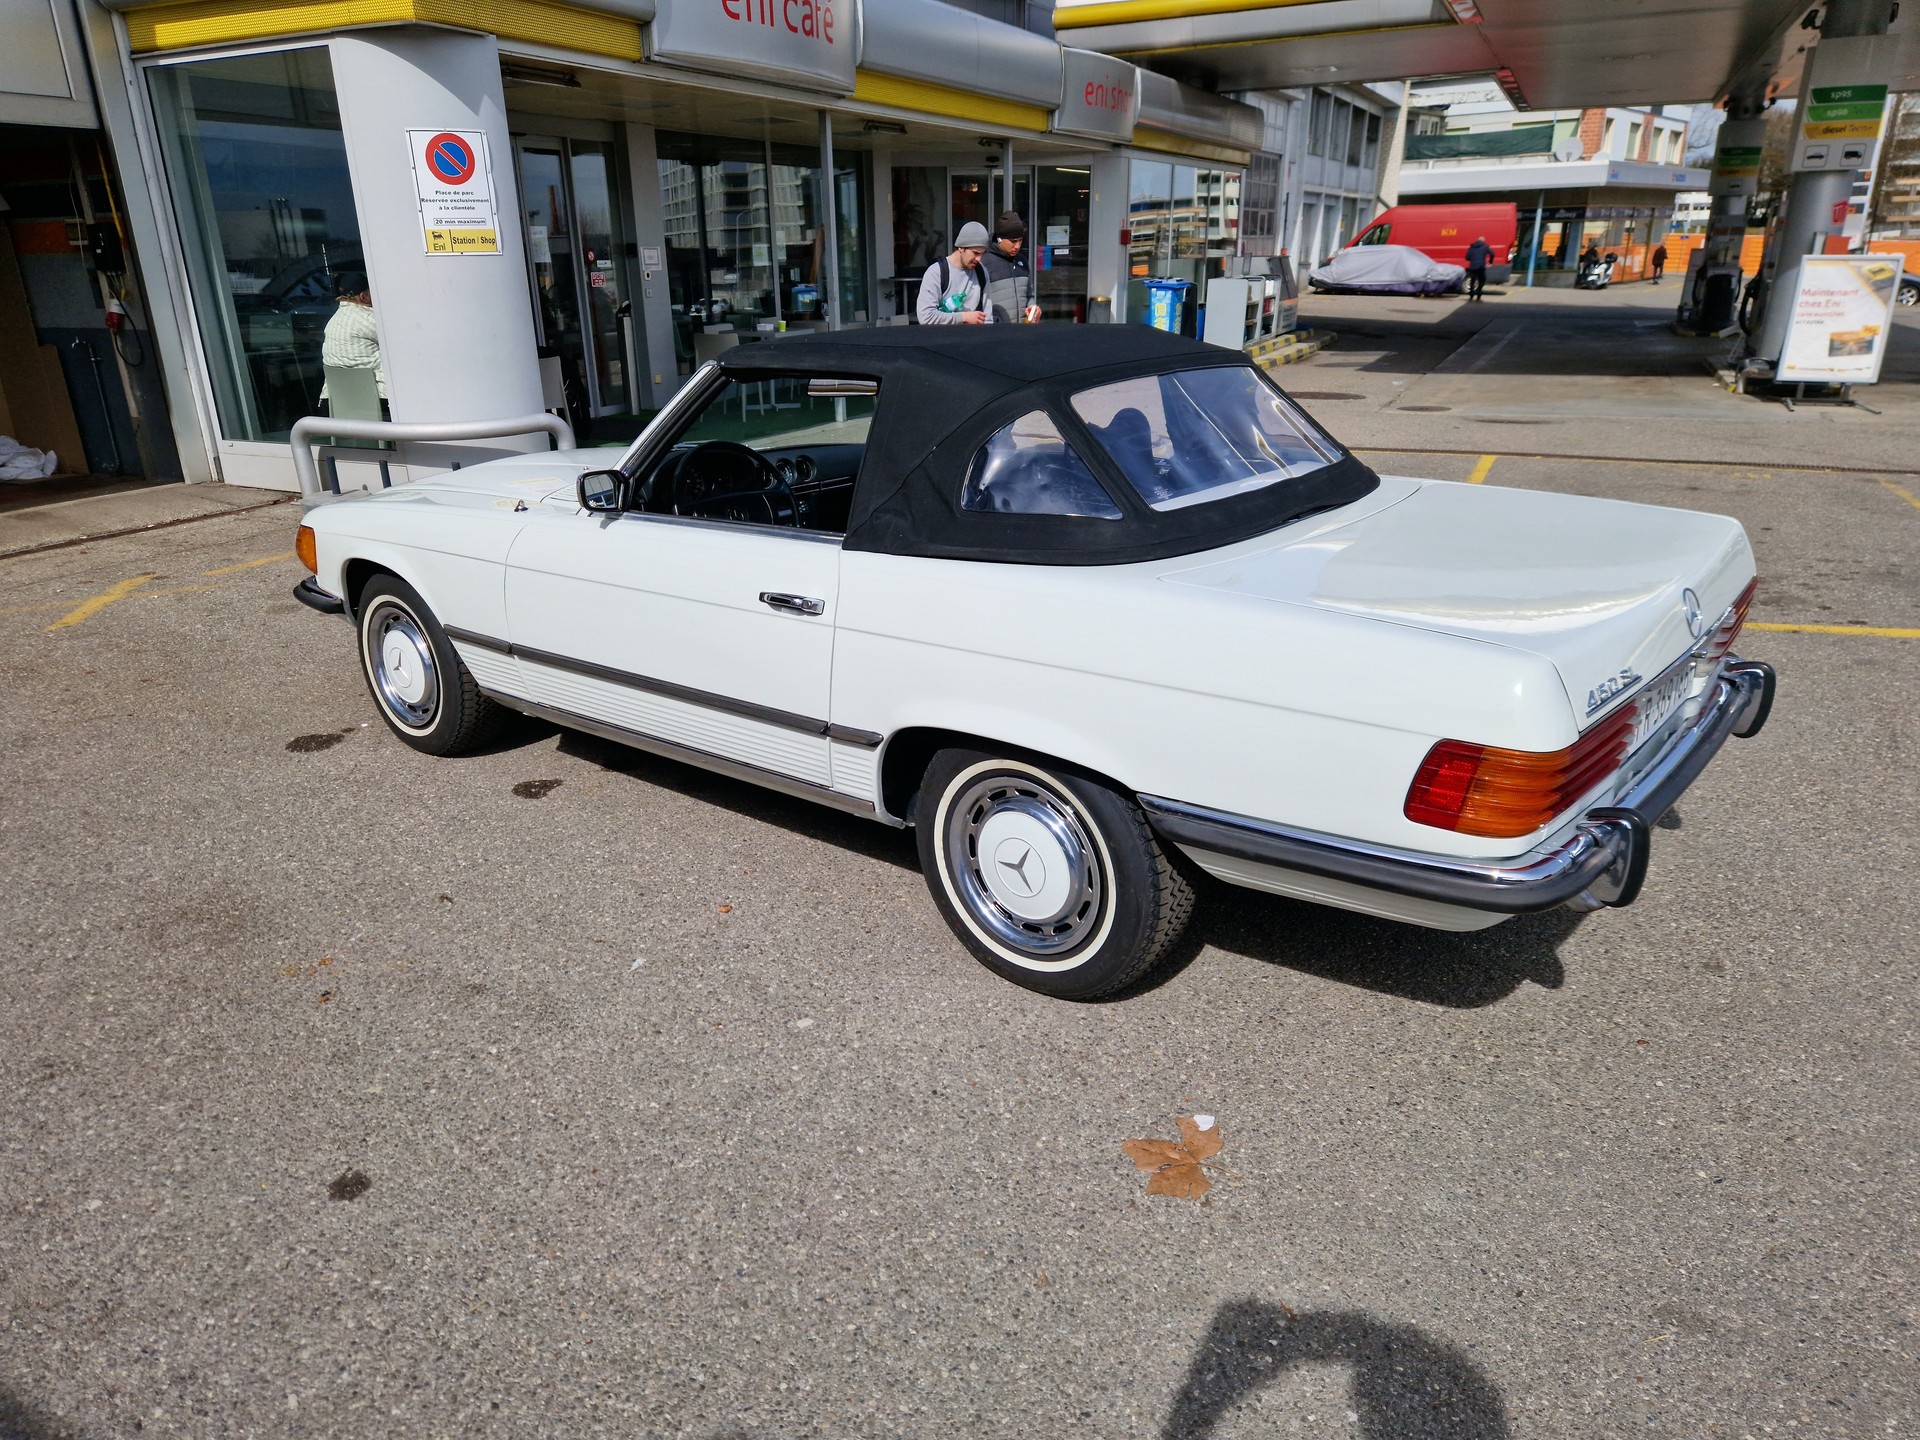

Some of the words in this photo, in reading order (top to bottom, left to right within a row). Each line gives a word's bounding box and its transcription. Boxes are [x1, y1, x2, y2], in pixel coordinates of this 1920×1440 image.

[1084, 75, 1109, 108] eni
[1830, 89, 1853, 100] sp95
[1822, 124, 1847, 135] diesel
[452, 236, 476, 244] Station
[480, 236, 496, 245] Shop
[433, 243, 446, 251] Eni
[1801, 288, 1860, 297] Maintenant
[1798, 299, 1822, 308] chez
[1587, 676, 1619, 709] 450
